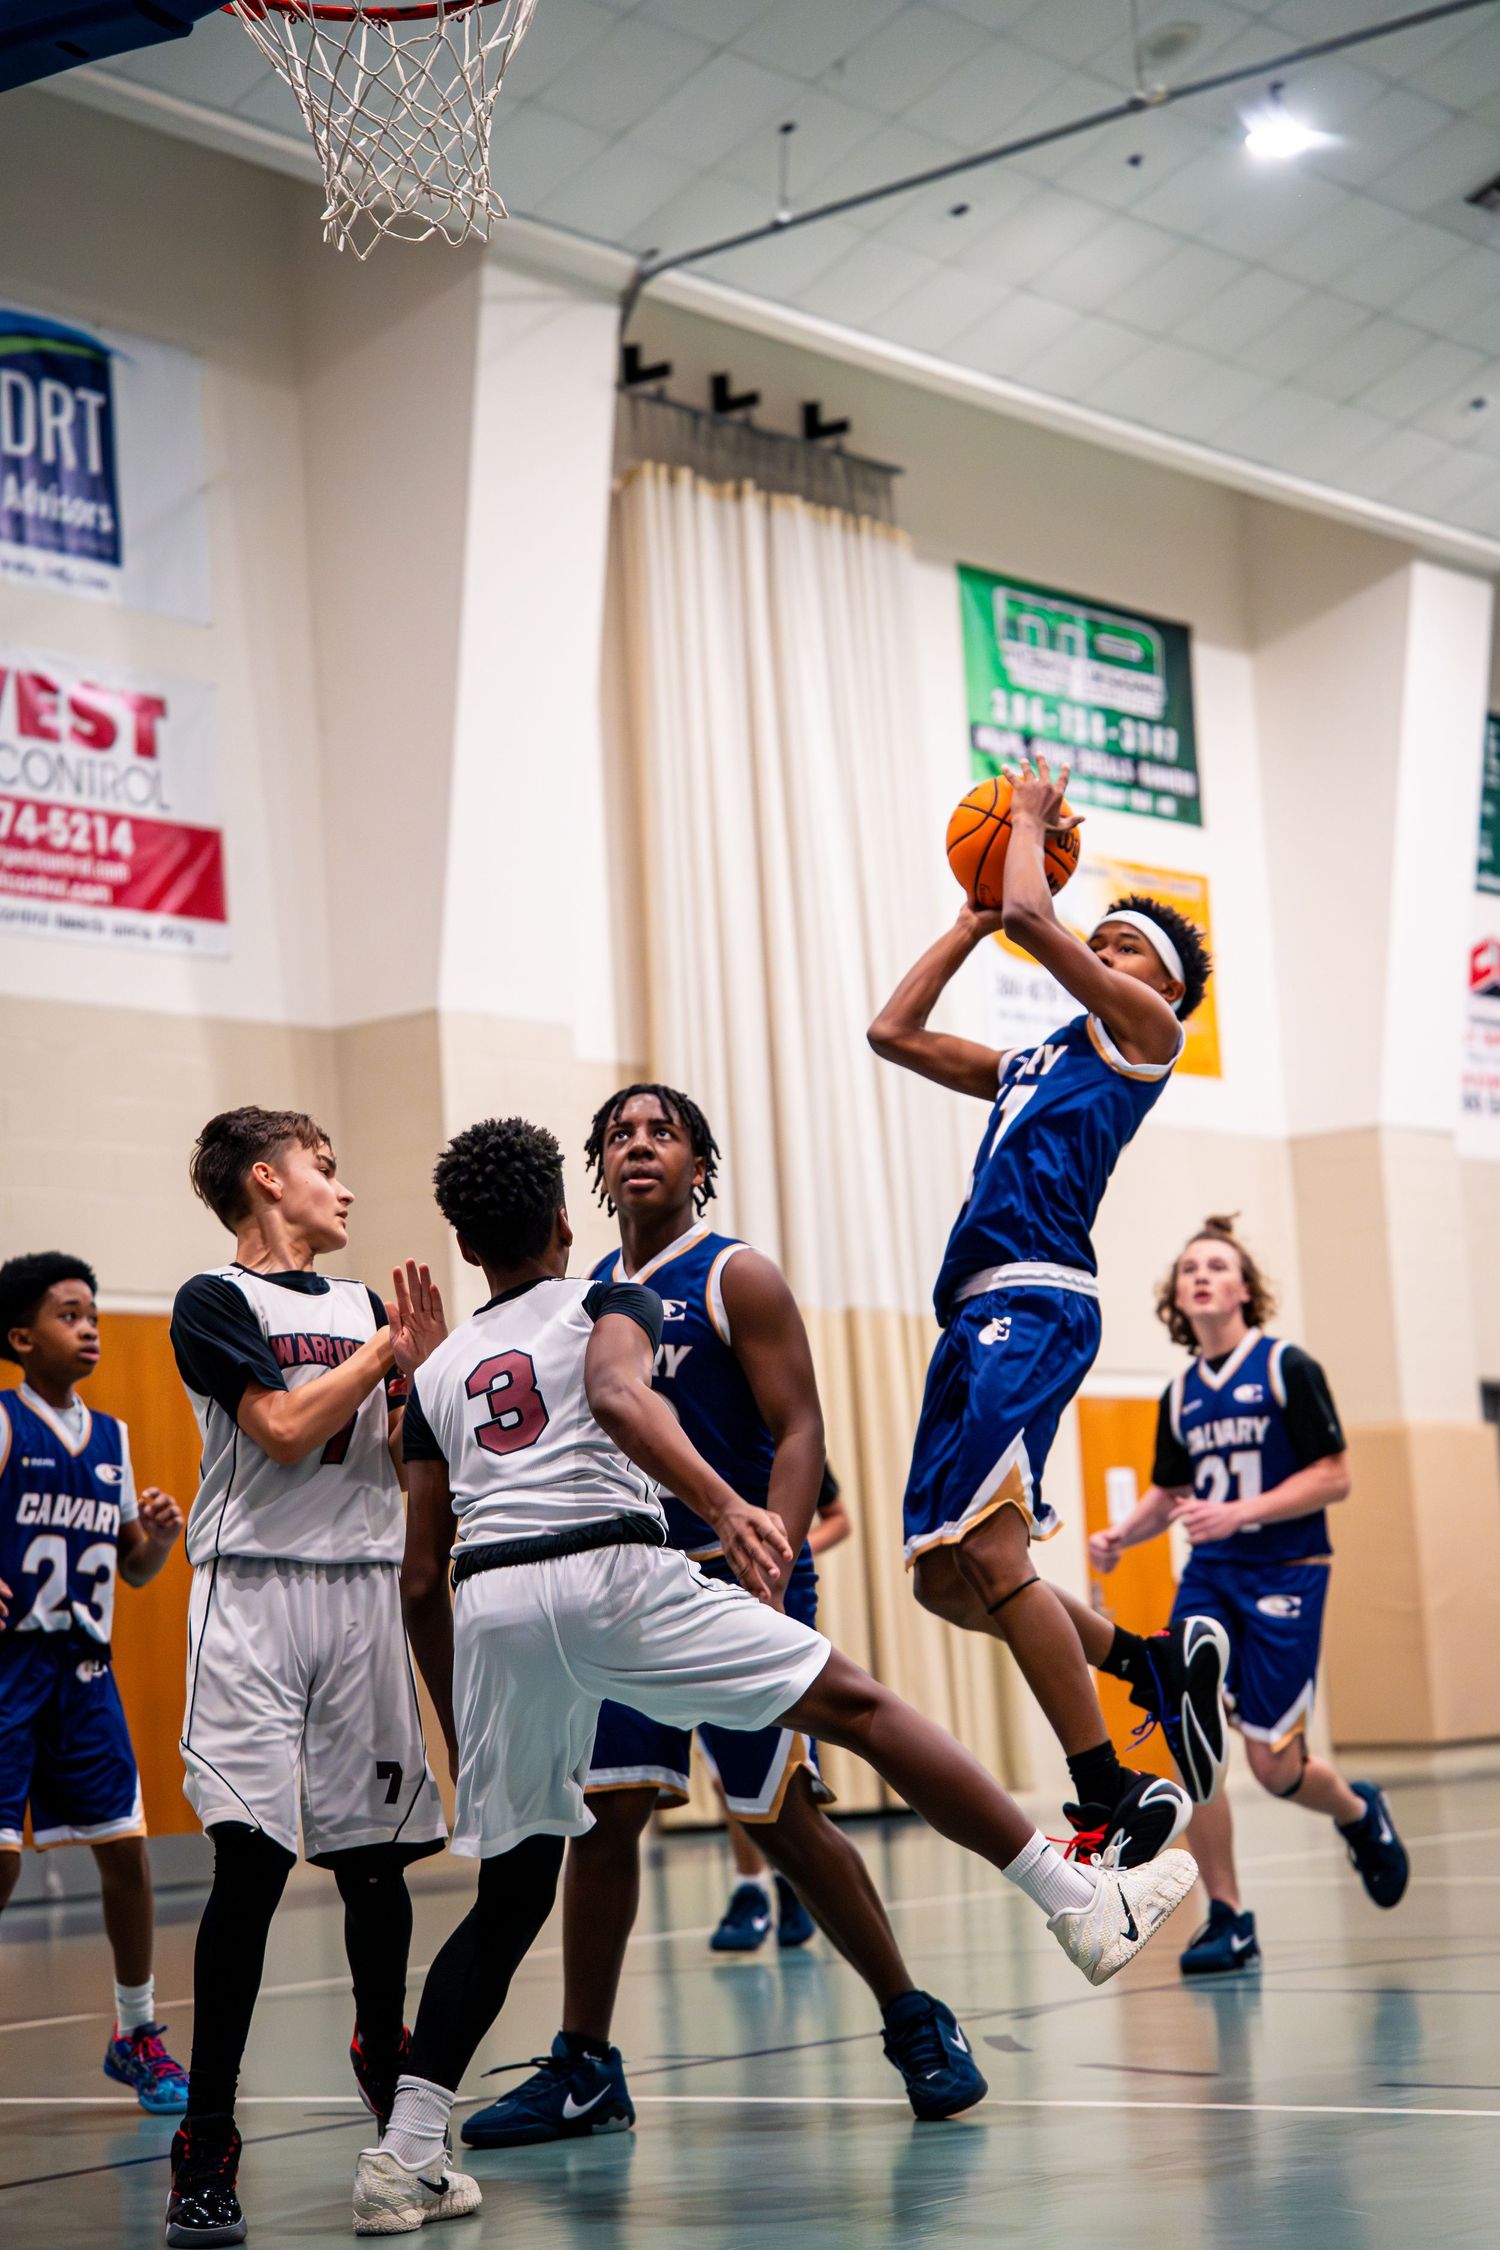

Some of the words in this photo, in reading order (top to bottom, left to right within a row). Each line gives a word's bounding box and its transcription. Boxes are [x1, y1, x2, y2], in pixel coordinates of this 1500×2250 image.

[0, 664, 168, 760] EST
[0, 740, 171, 813] CONTROL
[464, 1349, 550, 1456] 3
[1195, 1450, 1263, 1532] 21
[15, 1534, 118, 1644] 23
[376, 1761, 403, 1804] 7
